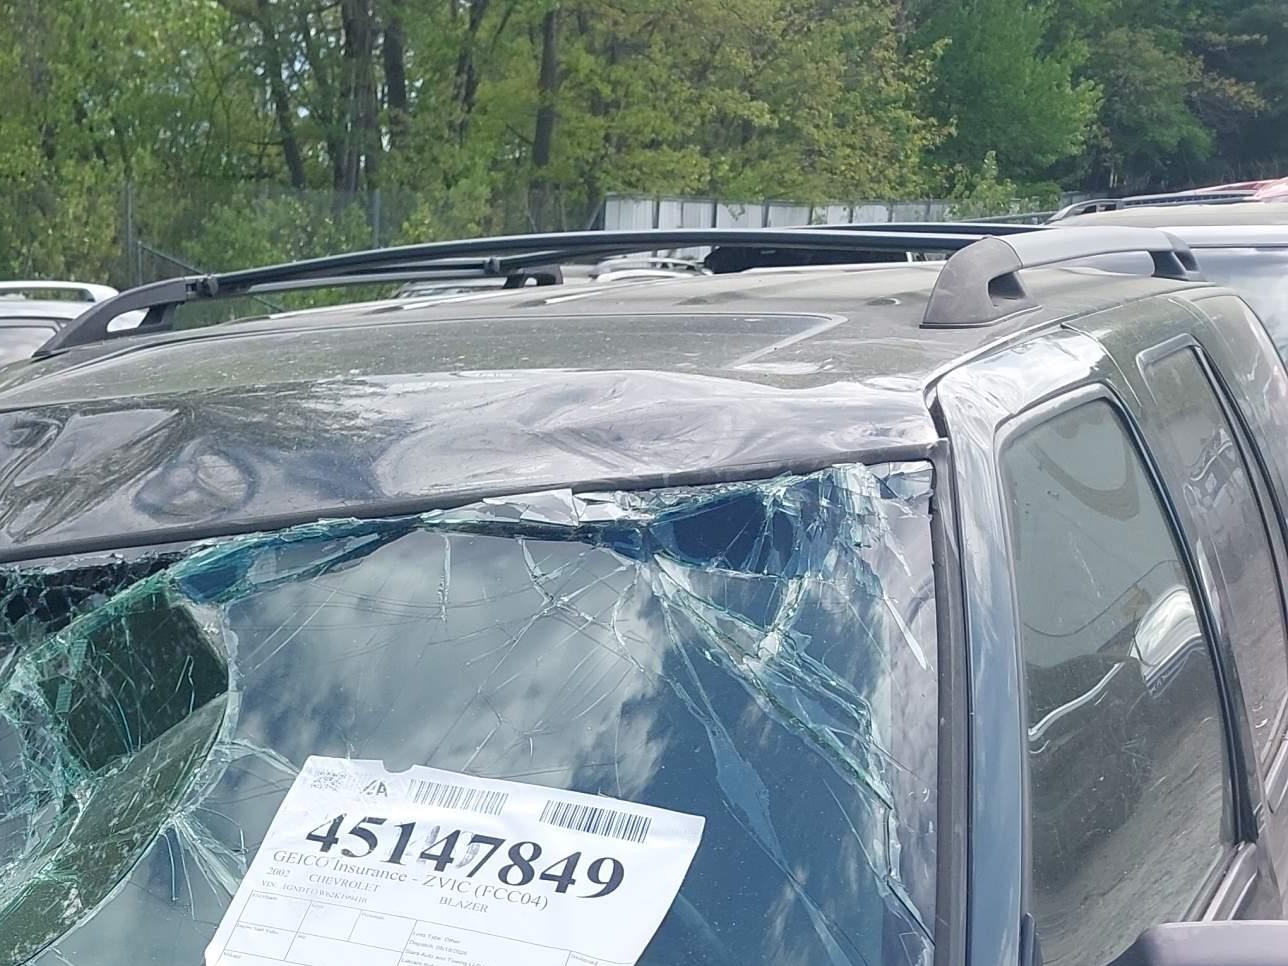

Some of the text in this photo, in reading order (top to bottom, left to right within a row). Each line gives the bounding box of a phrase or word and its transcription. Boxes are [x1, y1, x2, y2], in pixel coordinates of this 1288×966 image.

[273, 850, 329, 869] GEICO
[333, 859, 409, 882] Insurance
[422, 874, 472, 894] ZVIC
[474, 883, 549, 912] (FCC04)
[306, 812, 625, 899] 45147849
[265, 866, 489, 914] 2002 CHEVROLET BLAZER
